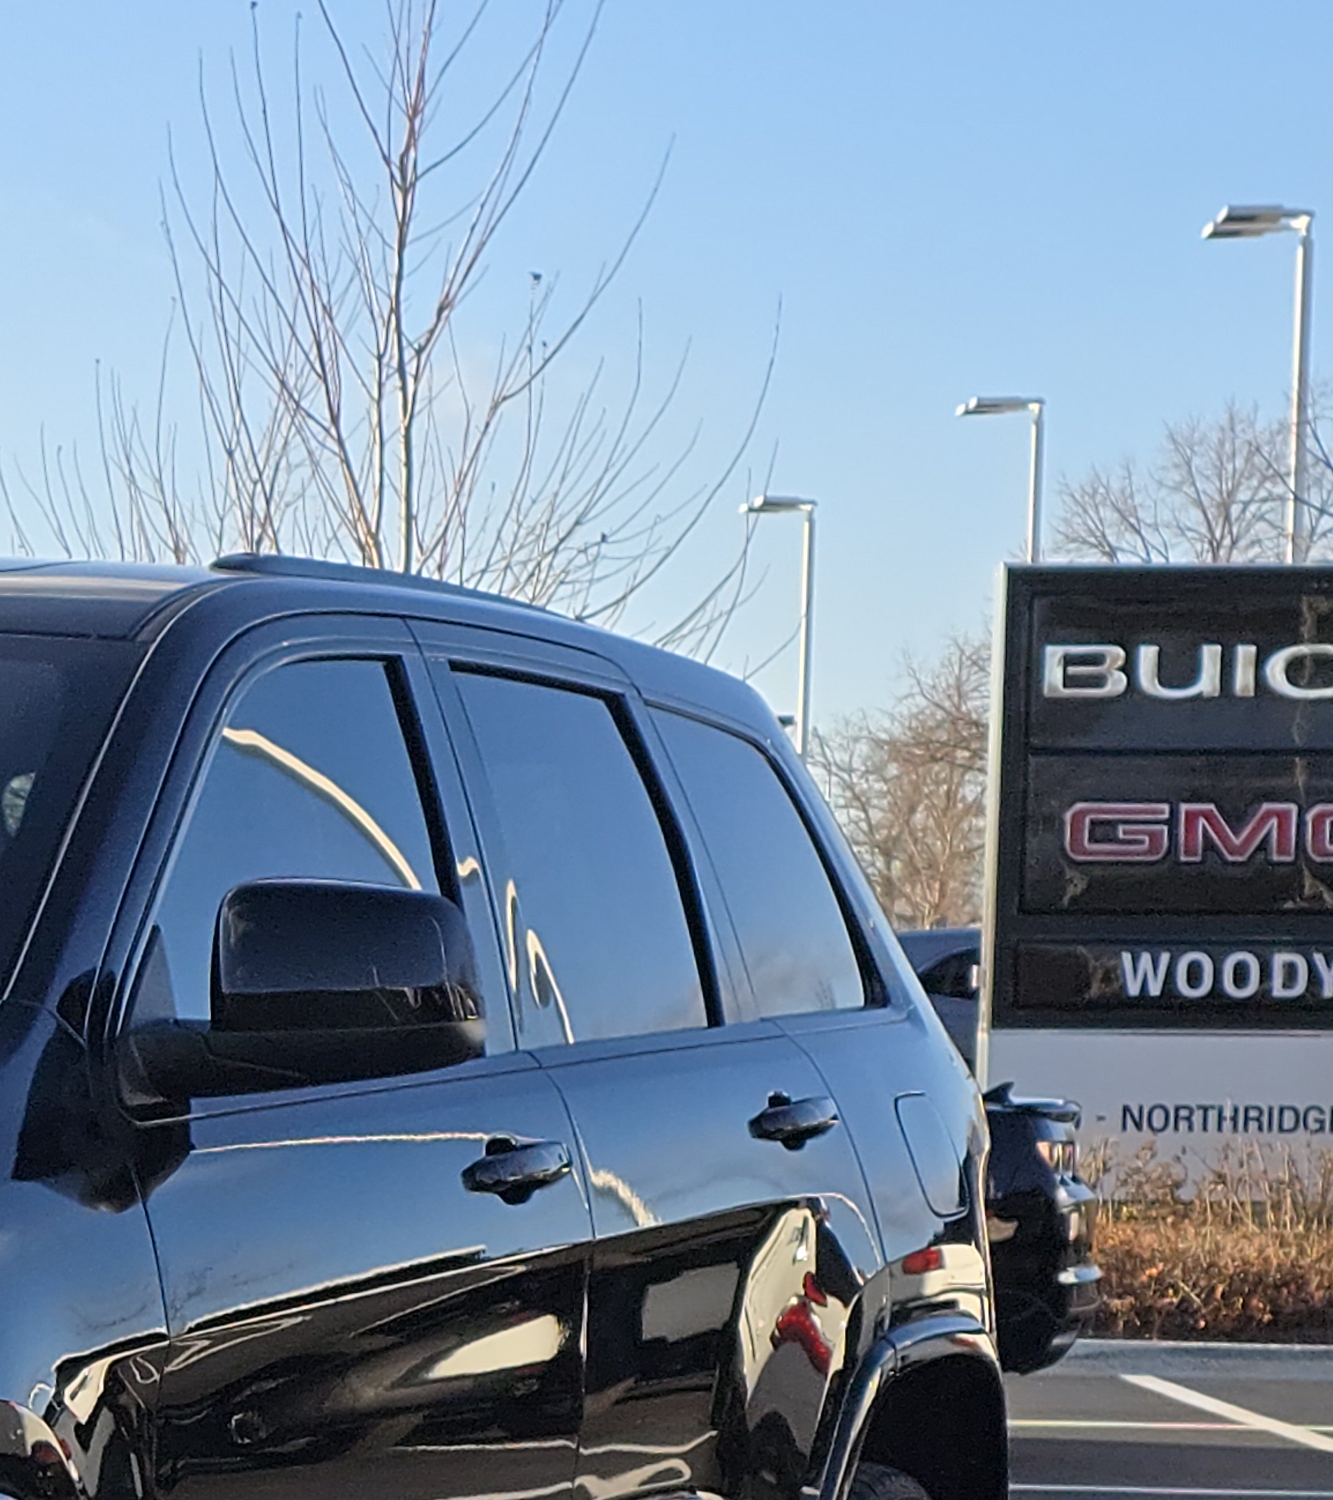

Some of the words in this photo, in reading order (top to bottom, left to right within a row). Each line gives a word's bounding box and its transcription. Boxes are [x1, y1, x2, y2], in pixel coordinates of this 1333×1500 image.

[1044, 643, 1333, 699] BUIC
[1065, 802, 1333, 861] GM
[1121, 951, 1333, 998] WOODY
[1121, 1103, 1333, 1134] NORTHRIDG
